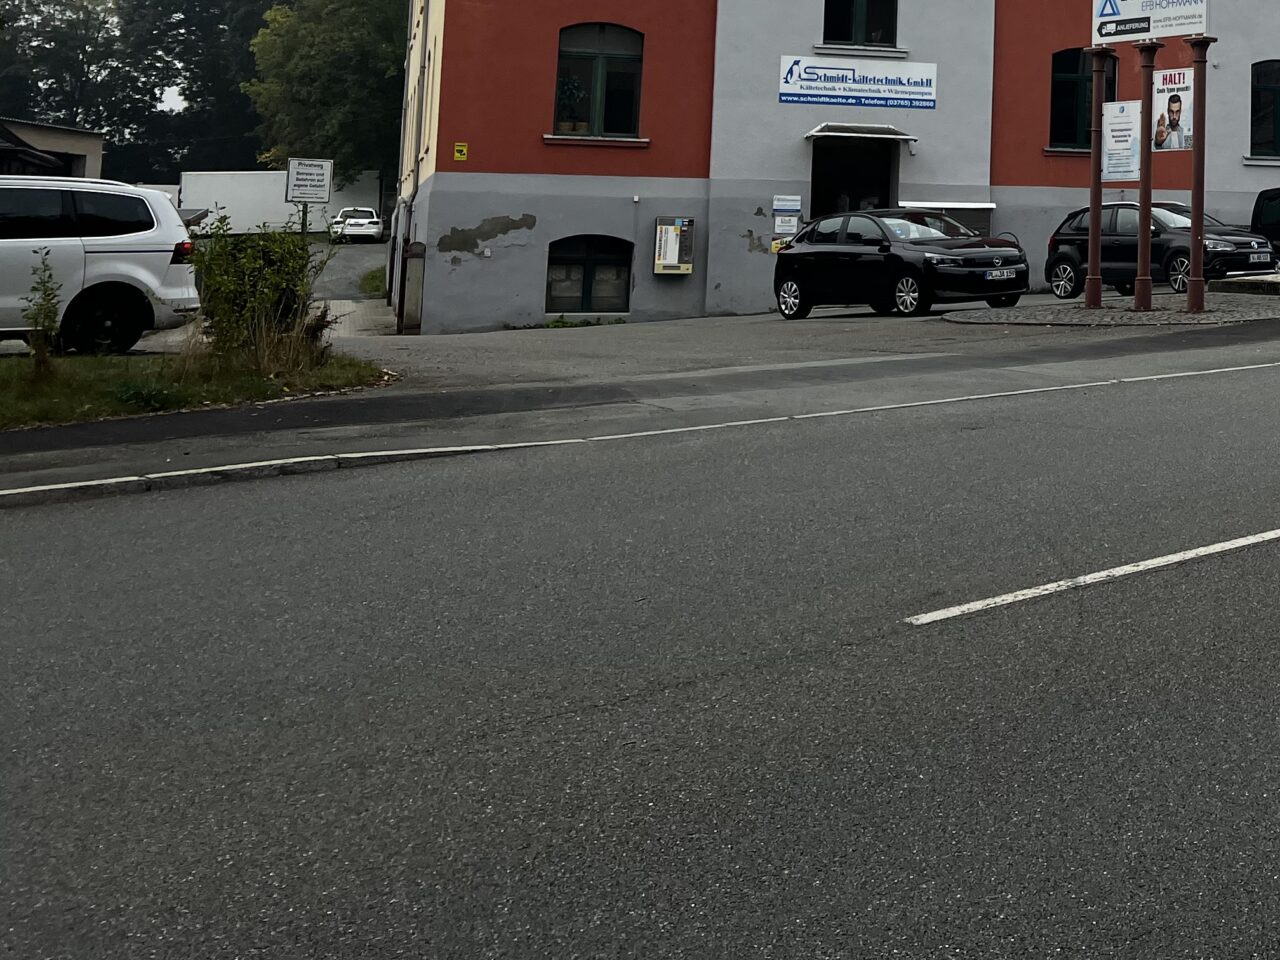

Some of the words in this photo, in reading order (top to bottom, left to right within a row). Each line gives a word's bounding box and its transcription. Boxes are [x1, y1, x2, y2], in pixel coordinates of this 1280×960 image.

[1116, 21, 1149, 31] ANLIEFERUNG
[907, 77, 932, 87] GmbH
[1162, 72, 1186, 86] HALT!
[800, 84, 837, 92] Kältetechnik
[887, 88, 933, 97] Wärmepumpen
